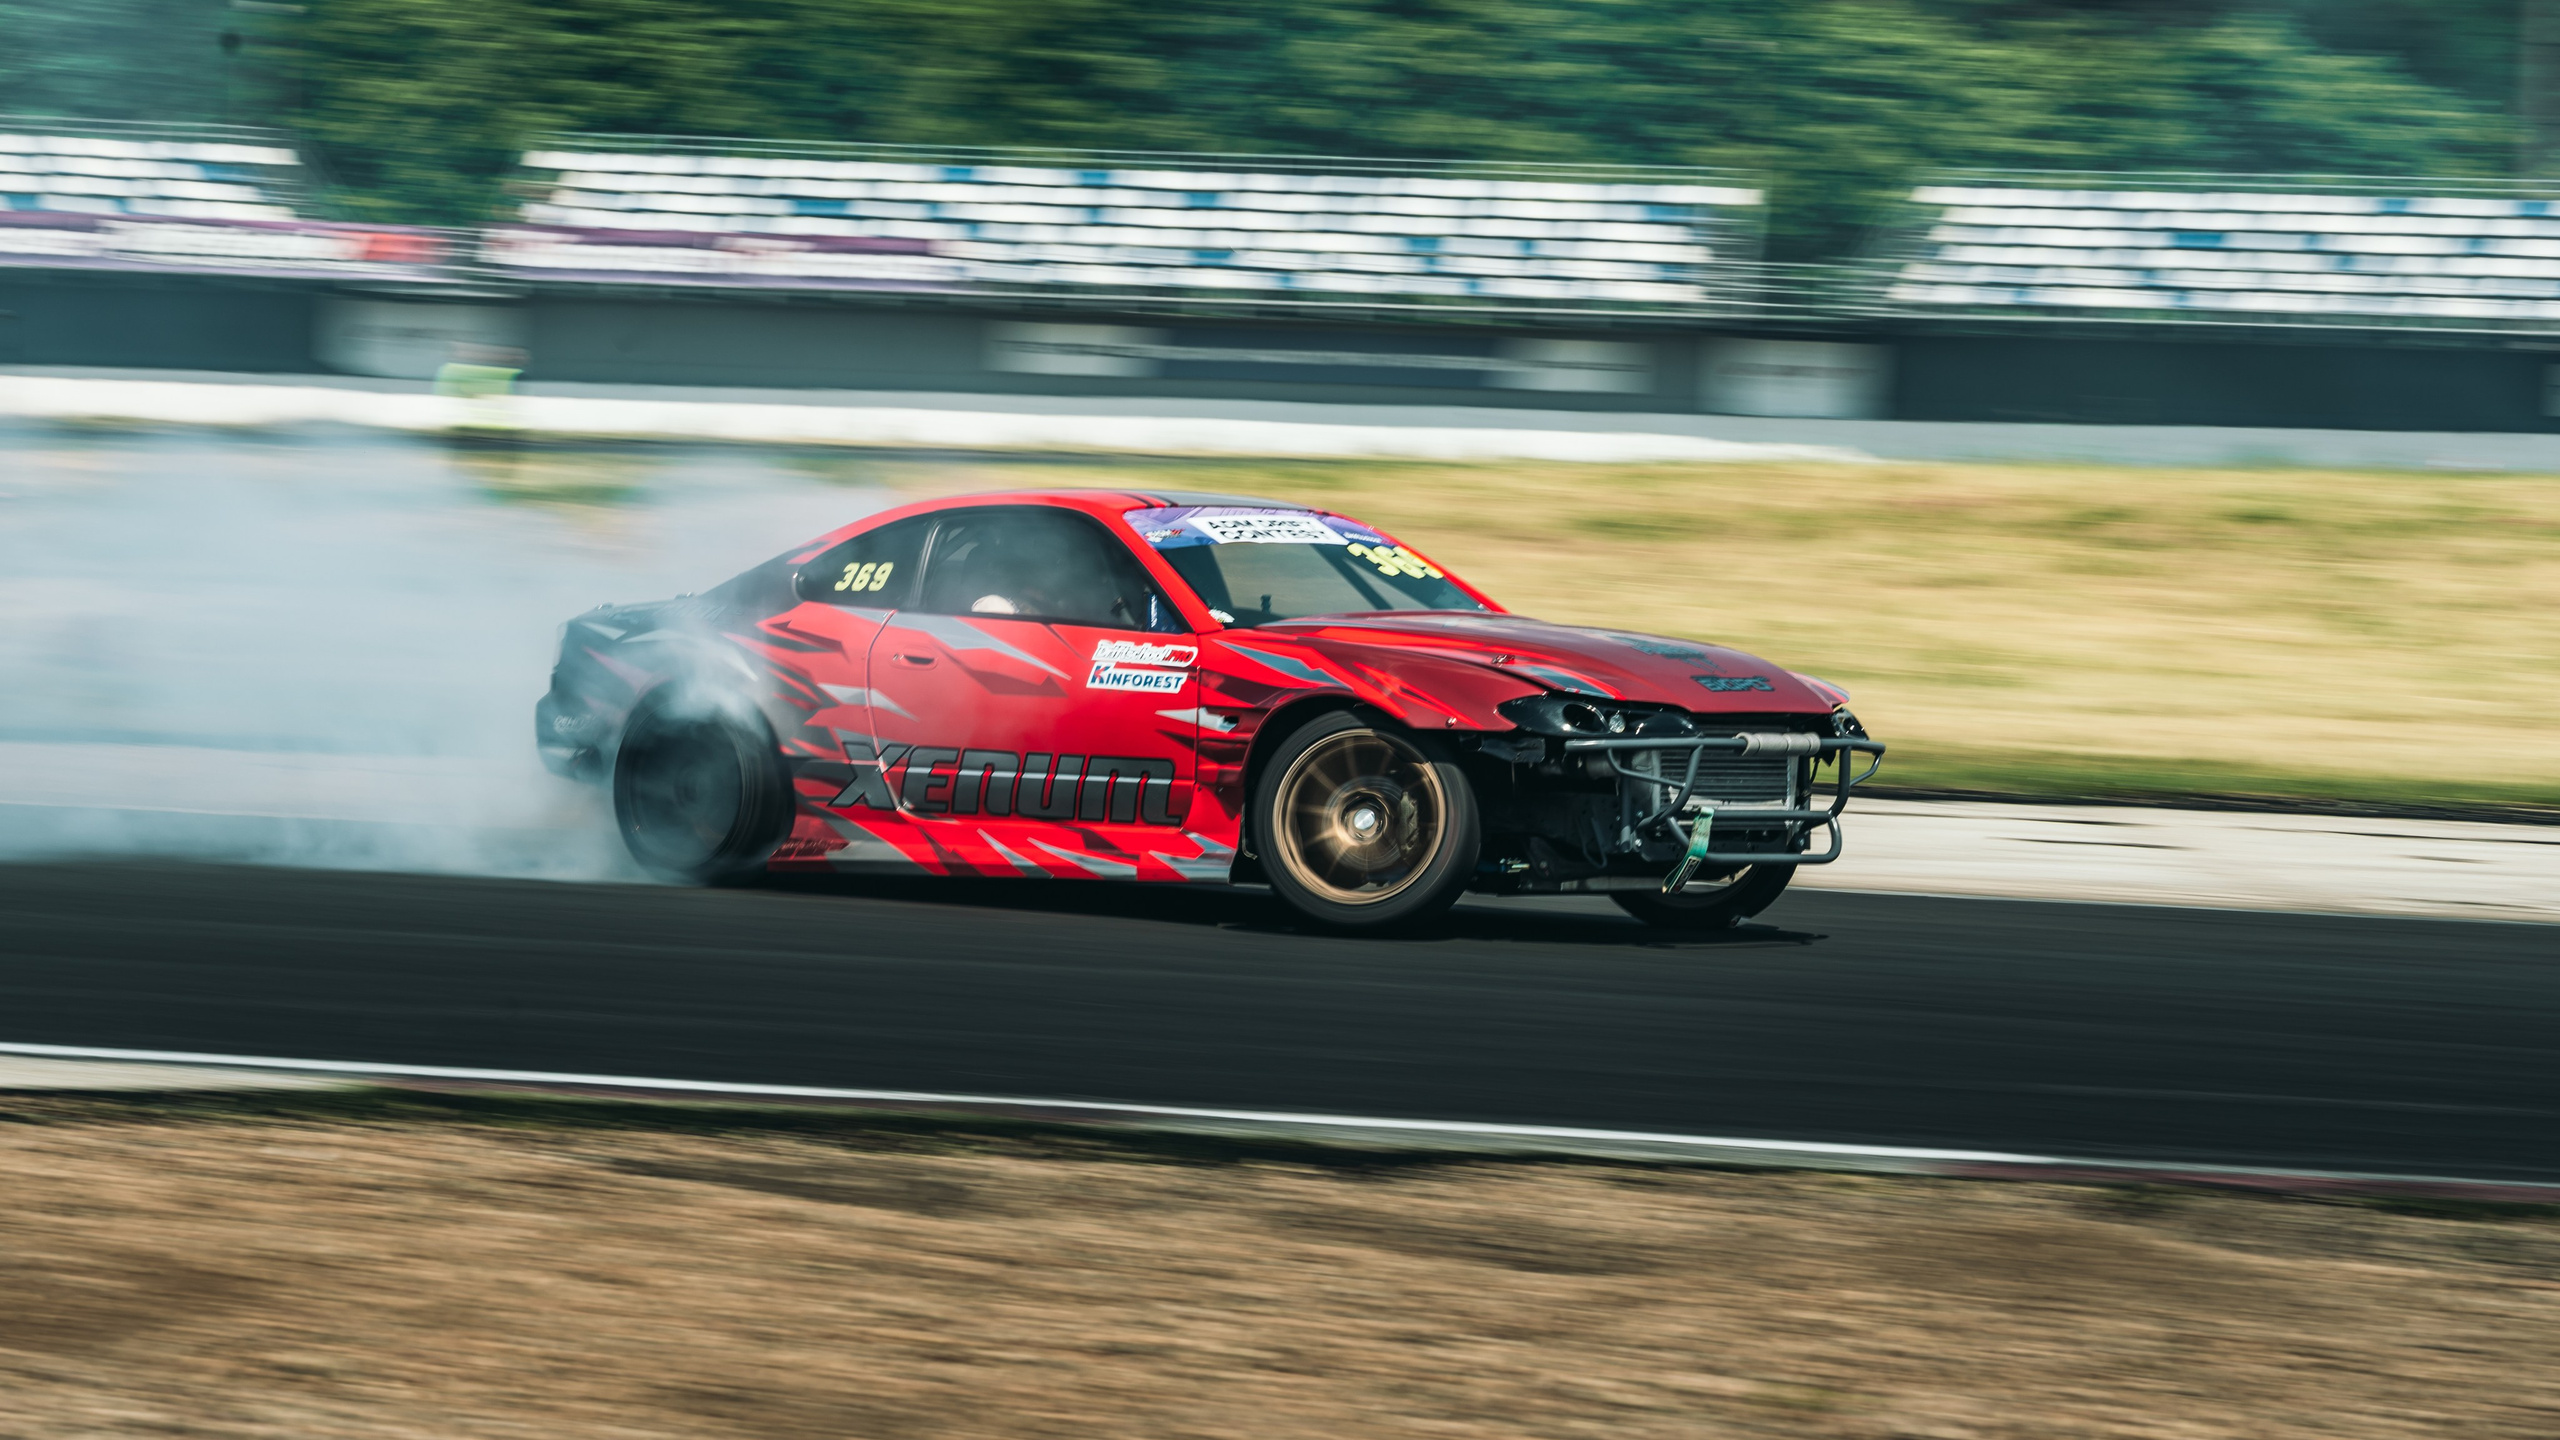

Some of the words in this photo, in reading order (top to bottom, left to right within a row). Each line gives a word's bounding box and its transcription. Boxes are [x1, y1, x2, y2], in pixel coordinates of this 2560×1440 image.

[1219, 529, 1331, 540] CONTEST
[833, 562, 895, 592] 369
[1090, 665, 1184, 690] KINFOREST
[827, 741, 1184, 827] XENUM
